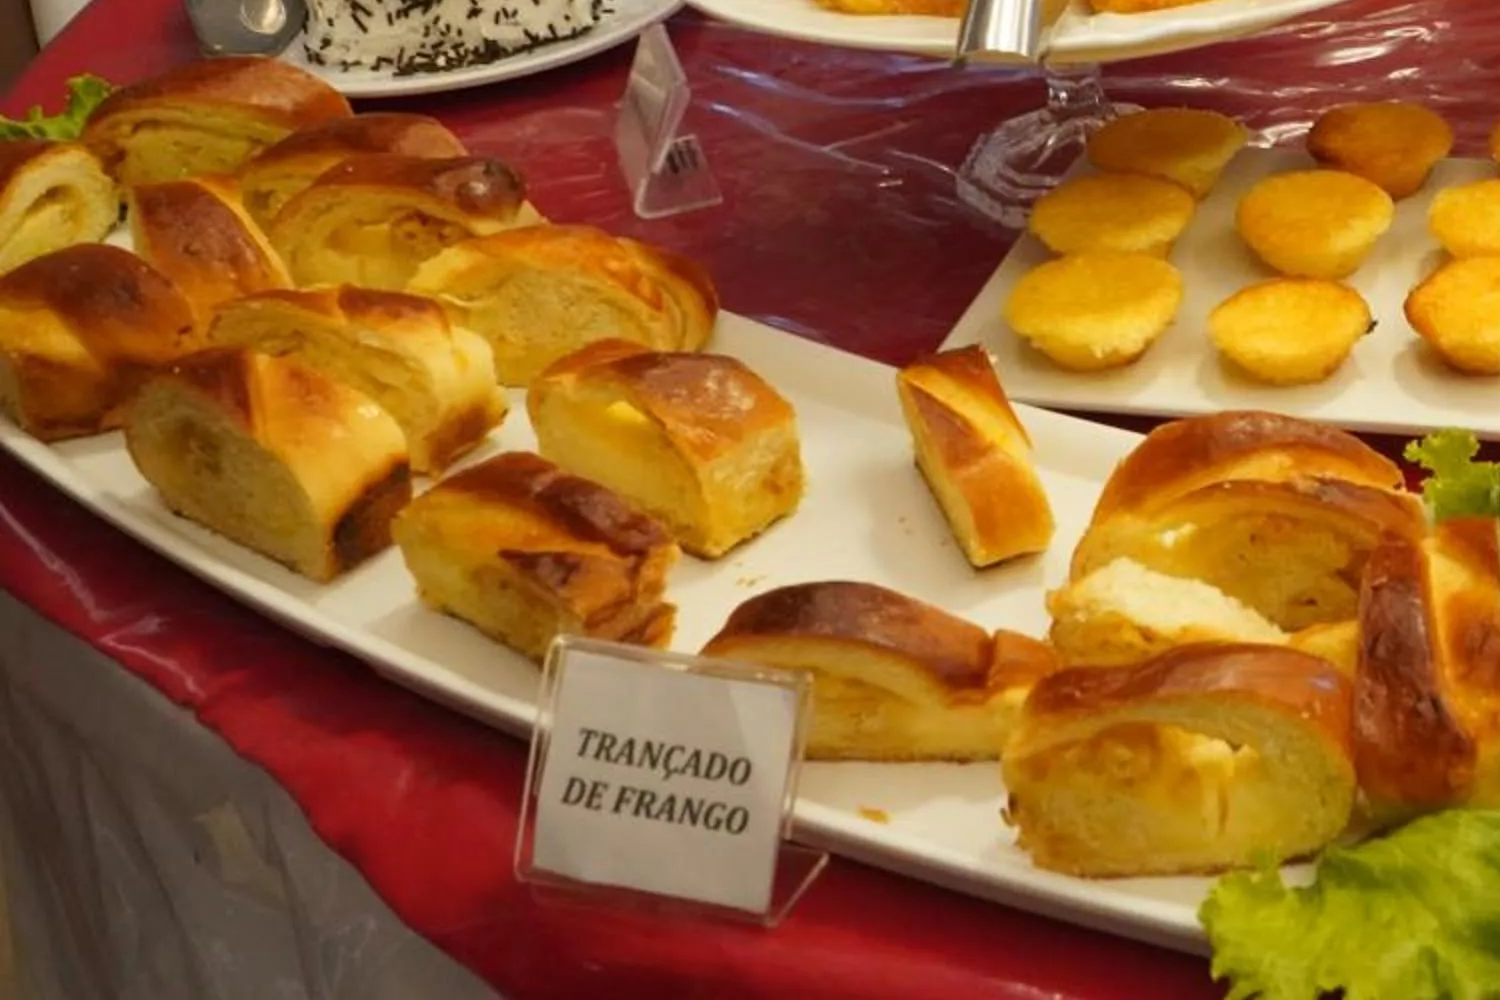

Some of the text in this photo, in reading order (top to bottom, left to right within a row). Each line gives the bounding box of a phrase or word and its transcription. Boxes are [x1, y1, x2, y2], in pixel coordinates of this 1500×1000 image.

[577, 727, 752, 786] TRANÇADO
[561, 777, 750, 835] DE FRANGO
